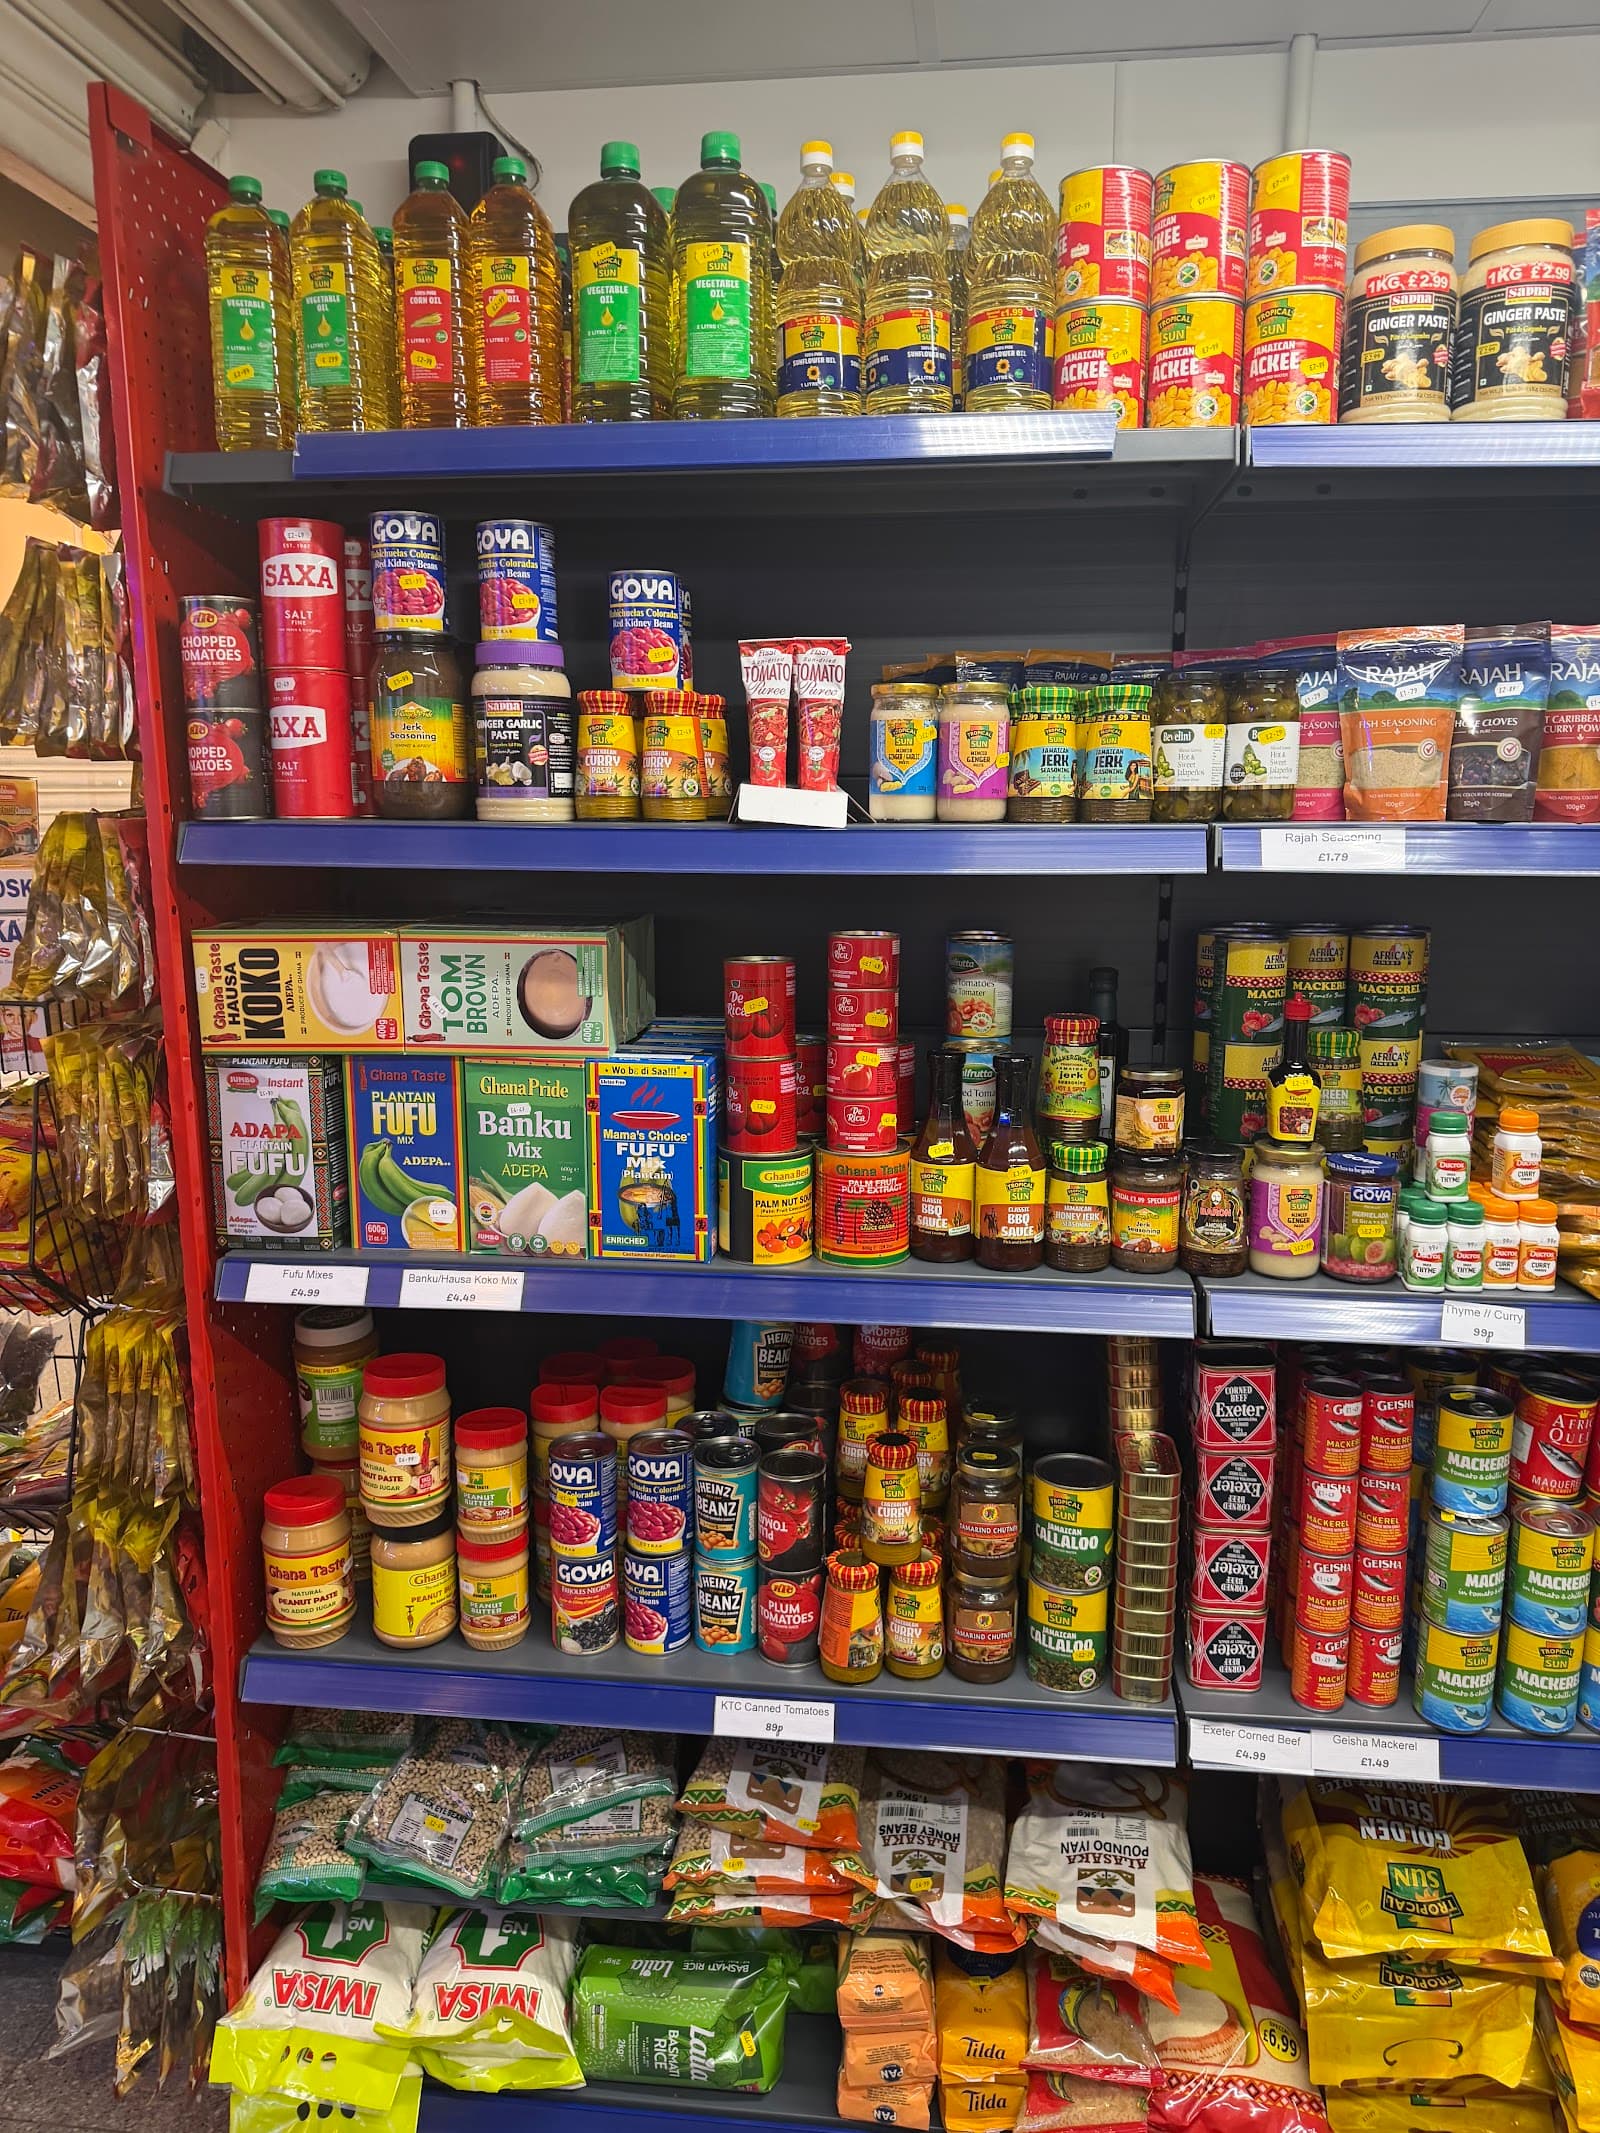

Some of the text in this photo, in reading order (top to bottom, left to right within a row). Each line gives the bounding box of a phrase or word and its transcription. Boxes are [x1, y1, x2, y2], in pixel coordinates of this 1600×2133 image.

[598, 269, 617, 278] SUN
[708, 262, 728, 271] SUN
[417, 273, 434, 284] SUN
[1488, 268, 1523, 285] 1KG
[236, 281, 256, 293] SUN
[587, 286, 628, 295] VEGETABLE
[696, 279, 739, 289] VEGETABLE
[1367, 276, 1400, 293] 1KG
[600, 296, 614, 304] OIL
[710, 288, 725, 298] OIL
[317, 303, 329, 313] OIL
[1257, 307, 1293, 322] TROPICAL
[1158, 315, 1192, 329] TROPICAL
[1483, 306, 1566, 325] GINGER PASTE
[1066, 317, 1102, 331] TROPICAL
[1368, 314, 1448, 332] GINGER PASTE
[1071, 332, 1095, 343] SUN
[1163, 330, 1185, 343] SUN
[1262, 324, 1286, 337] SUN
[1063, 349, 1105, 362] JAMAICAN
[1155, 346, 1195, 360] JAMAICAN
[1253, 341, 1296, 357] JAMAICAN
[1153, 358, 1199, 380] ACKEE
[1250, 351, 1299, 377] ACKEE
[1060, 361, 1109, 384] ACKEE
[373, 519, 438, 542] GOYA
[265, 564, 334, 590] SAXA
[507, 569, 531, 579] Beans
[611, 579, 675, 602] GOYA
[284, 609, 313, 620] SALT
[743, 663, 791, 682] TOMATO
[797, 663, 844, 683] TOMATO
[1366, 663, 1436, 683] RAJAH
[402, 723, 422, 732] Jerk
[476, 718, 542, 730] GINGER GARLIC
[1381, 717, 1437, 728] SEASONING
[1482, 717, 1518, 727] CLOVES
[390, 732, 437, 743] Seasoning
[491, 730, 520, 740] PASTE
[277, 761, 299, 771] SALT
[585, 753, 621, 769] CURRY
[1041, 755, 1069, 767] JERK
[1095, 755, 1123, 767] JERK
[591, 767, 613, 775] PASTE
[1285, 833, 1382, 845] Rajah Seasoning
[1318, 852, 1349, 863] £1.79
[416, 943, 429, 980] Taste
[210, 943, 226, 1030] Ghana Taste
[226, 962, 239, 1025] HAUSA
[1358, 983, 1420, 994] MACKEREL
[239, 948, 286, 1040] KOKO
[440, 955, 464, 1033] TOM
[465, 954, 487, 1034] BROWN
[268, 1077, 304, 1088] Instant
[370, 1069, 447, 1082] Ghana Taste
[480, 1076, 569, 1098] Ghana Pride
[371, 1091, 436, 1103] PLANTAIN
[371, 1102, 437, 1136] FUFU
[478, 1110, 572, 1140] Banku
[230, 1122, 303, 1139] ADAPA
[603, 1129, 645, 1141] Mama's
[240, 1139, 293, 1151] PLANTAIN
[396, 1136, 414, 1145] MIX
[507, 1141, 542, 1159] Mix
[616, 1143, 675, 1157] FUFU
[229, 1151, 305, 1176] FUFU
[836, 1164, 877, 1177] Ghana
[502, 1163, 549, 1179] ADEPA
[764, 1170, 794, 1183] Ghana
[924, 1183, 942, 1192] SUN
[1012, 1191, 1030, 1200] SUN
[1353, 1188, 1391, 1202] GOYA
[922, 1204, 943, 1218] BBQ
[918, 1215, 948, 1229] SAUCE
[1008, 1213, 1031, 1227] BBQ
[1001, 1226, 1035, 1237] SAUCE
[606, 1236, 645, 1246] ENRICHED
[283, 1270, 334, 1280] Fufu Mixes
[408, 1274, 518, 1286] Banku/Hausa Koko Mix
[290, 1288, 320, 1297] £4.99
[446, 1293, 476, 1302] £4.49
[1446, 1305, 1481, 1318] Thyme
[1494, 1311, 1524, 1323] Curry
[1473, 1327, 1494, 1343] 99p
[1215, 1402, 1264, 1417] Exeter
[376, 1443, 416, 1456] Taste
[1476, 1440, 1498, 1449] SUN
[1361, 1476, 1401, 1491] GEISHA
[698, 1483, 733, 1499] HEINZ
[885, 1488, 904, 1499] SUN
[696, 1498, 737, 1517] BEANZ
[1049, 1498, 1083, 1511] TROPICAL
[878, 1505, 911, 1519] CURRY
[1054, 1510, 1076, 1521] SUN
[884, 1517, 906, 1526] PASTE
[1306, 1514, 1349, 1528] MACKEREL
[1048, 1522, 1083, 1536] JAMAICAN
[1035, 1526, 1099, 1550] CALLALOO
[269, 1562, 307, 1581] Ghana
[559, 1560, 614, 1583] GOYA
[700, 1574, 736, 1589] HEINZ
[278, 1590, 338, 1605] PEANUT PASTE
[700, 1592, 741, 1611] BEANZ
[768, 1600, 801, 1613] PLUM
[760, 1607, 814, 1625] TOMATOES
[1209, 1643, 1257, 1659] Exeter
[1540, 1647, 1573, 1658] TROPICAL
[1545, 1658, 1568, 1668] SUN
[721, 1701, 829, 1716] KTC Canned Tomatoes
[765, 1723, 784, 1737] 89p
[1203, 1725, 1301, 1746] Exeter Corned Beef
[1333, 1735, 1418, 1751] Geisha Mackerel
[1236, 1750, 1266, 1761] £4.99
[1361, 1758, 1389, 1768] £1.49
[1367, 1794, 1433, 1816] SELLA
[879, 1824, 961, 1842] HONEY BEANS
[1360, 1817, 1451, 1850] GOLDEN
[882, 1834, 960, 1852] ALASAKA
[1061, 1840, 1149, 1856] POUNDO IYAN
[1067, 1853, 1147, 1869] ALASAKA
[1394, 1866, 1440, 1889] SUN
[1384, 1894, 1457, 1914] TROPICAL
[631, 1959, 675, 1978] Laila
[272, 1968, 381, 2020] IWISA
[961, 2036, 1006, 2060] Tilda
[1263, 2029, 1298, 2058] £6.99
[654, 2038, 668, 2070] RICE
[667, 2029, 680, 2078] BASMATI
[689, 2024, 715, 2082] Laila
[961, 2086, 1007, 2111] Tilda
